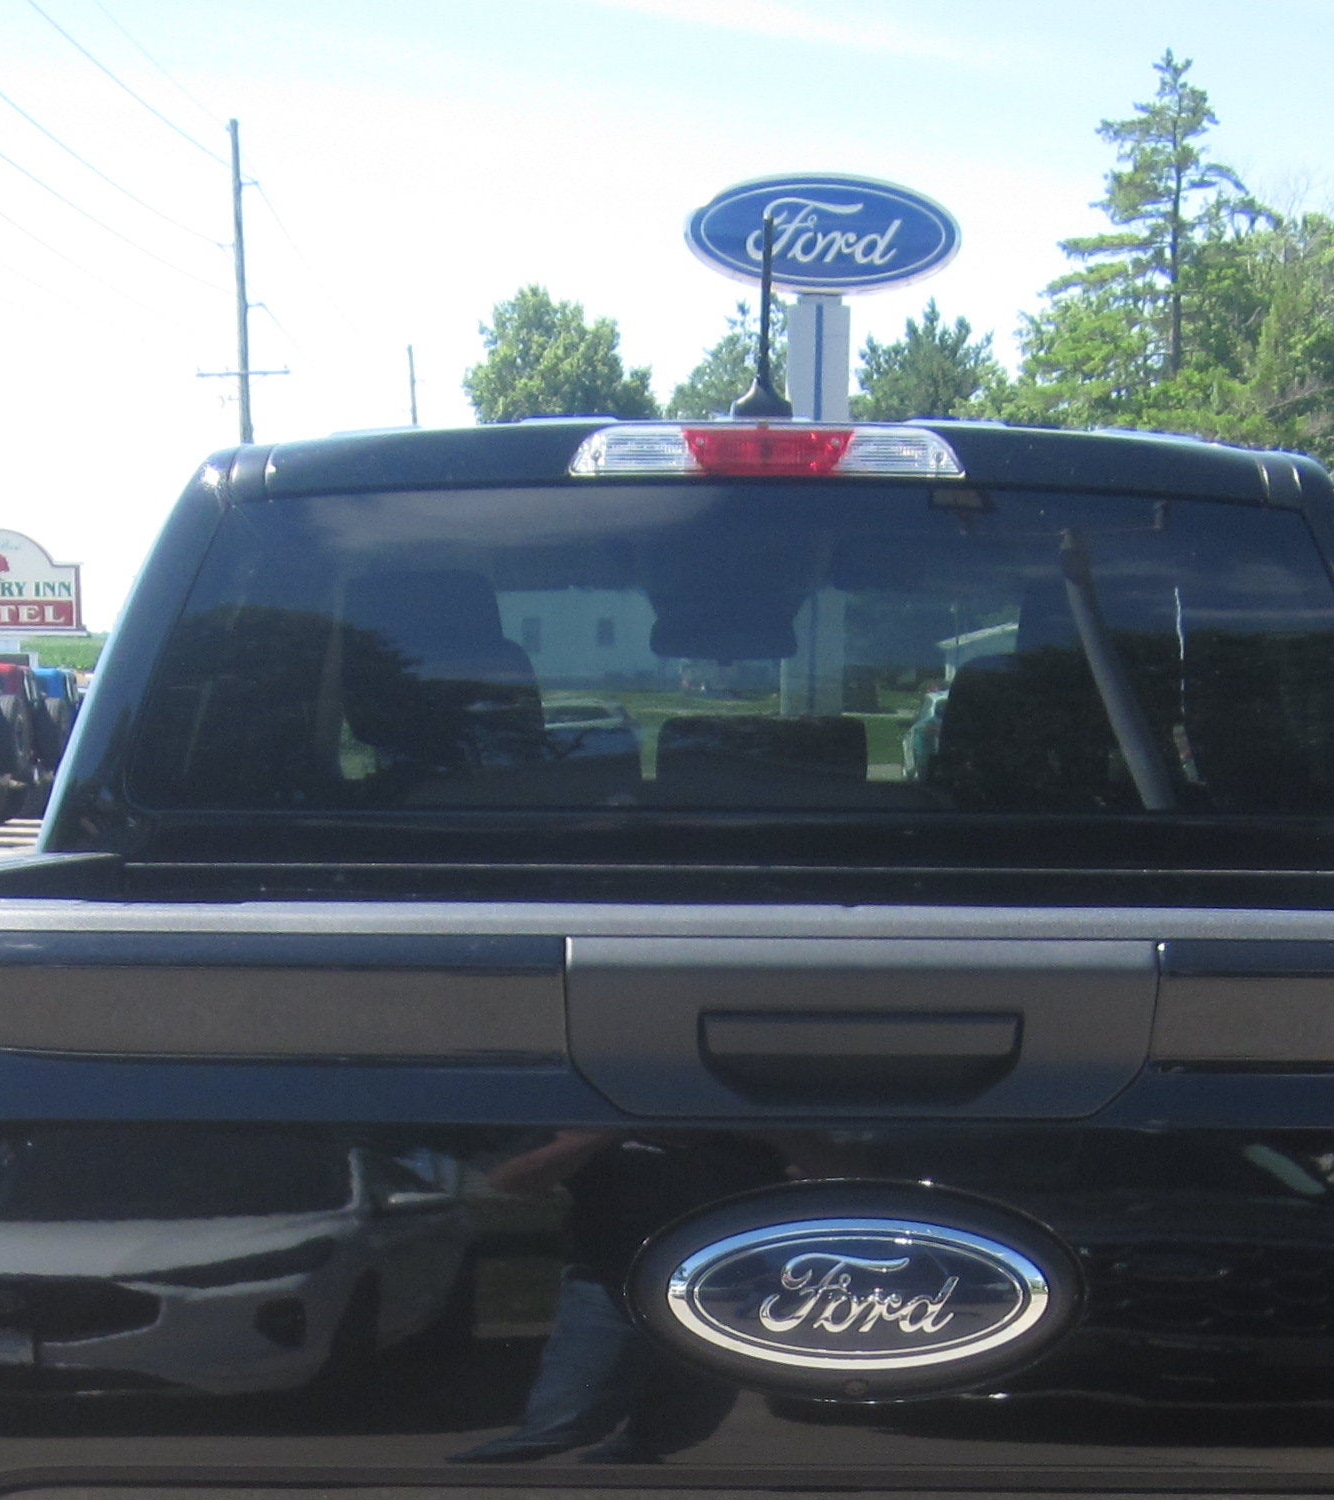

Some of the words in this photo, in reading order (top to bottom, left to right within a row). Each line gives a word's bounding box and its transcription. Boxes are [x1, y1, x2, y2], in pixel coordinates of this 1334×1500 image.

[745, 197, 903, 266] Ford
[33, 580, 73, 598] INN
[759, 1252, 960, 1334] Ford
